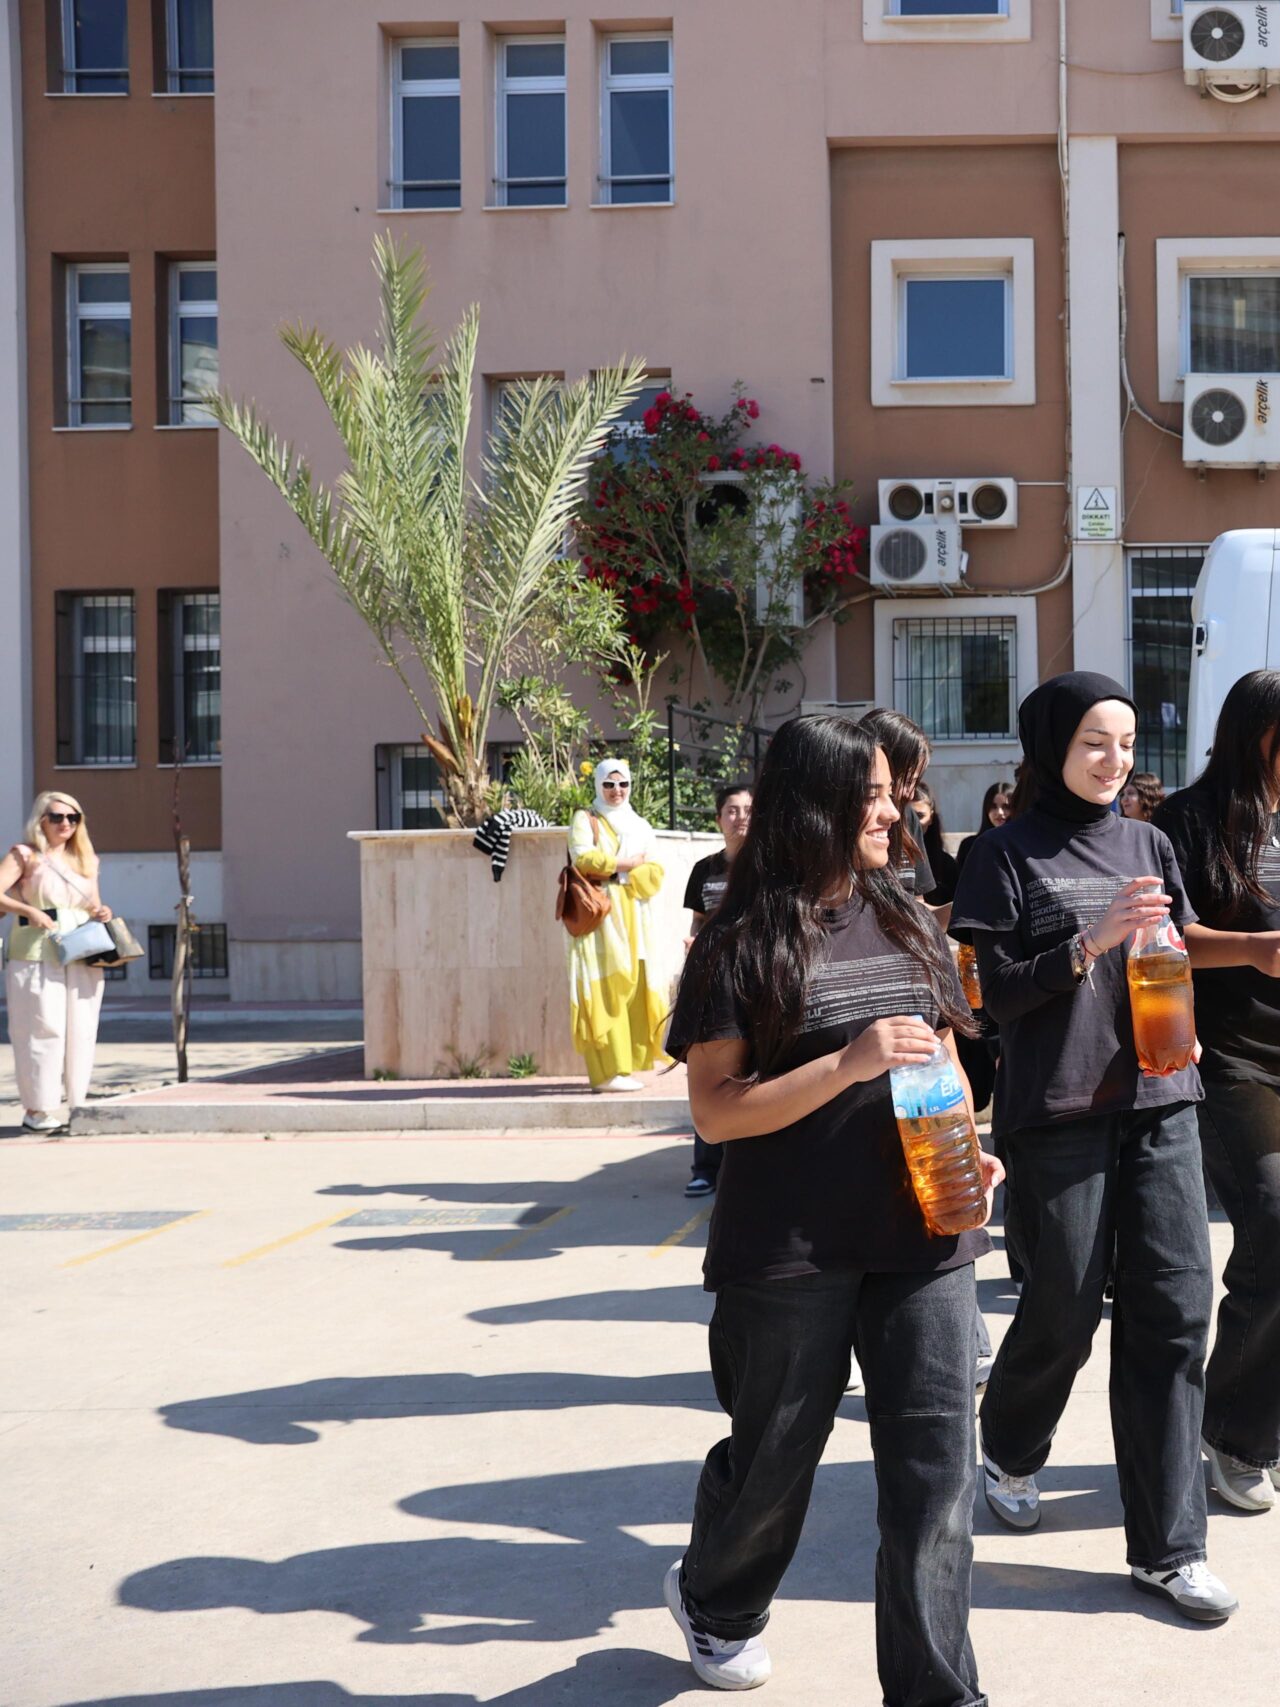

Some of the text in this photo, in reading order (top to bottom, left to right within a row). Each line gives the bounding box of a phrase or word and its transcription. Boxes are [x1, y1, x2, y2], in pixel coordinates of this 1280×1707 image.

[1256, 4, 1270, 48] arçelik
[1256, 378, 1270, 424] arçelik
[936, 528, 948, 567] arçelik
